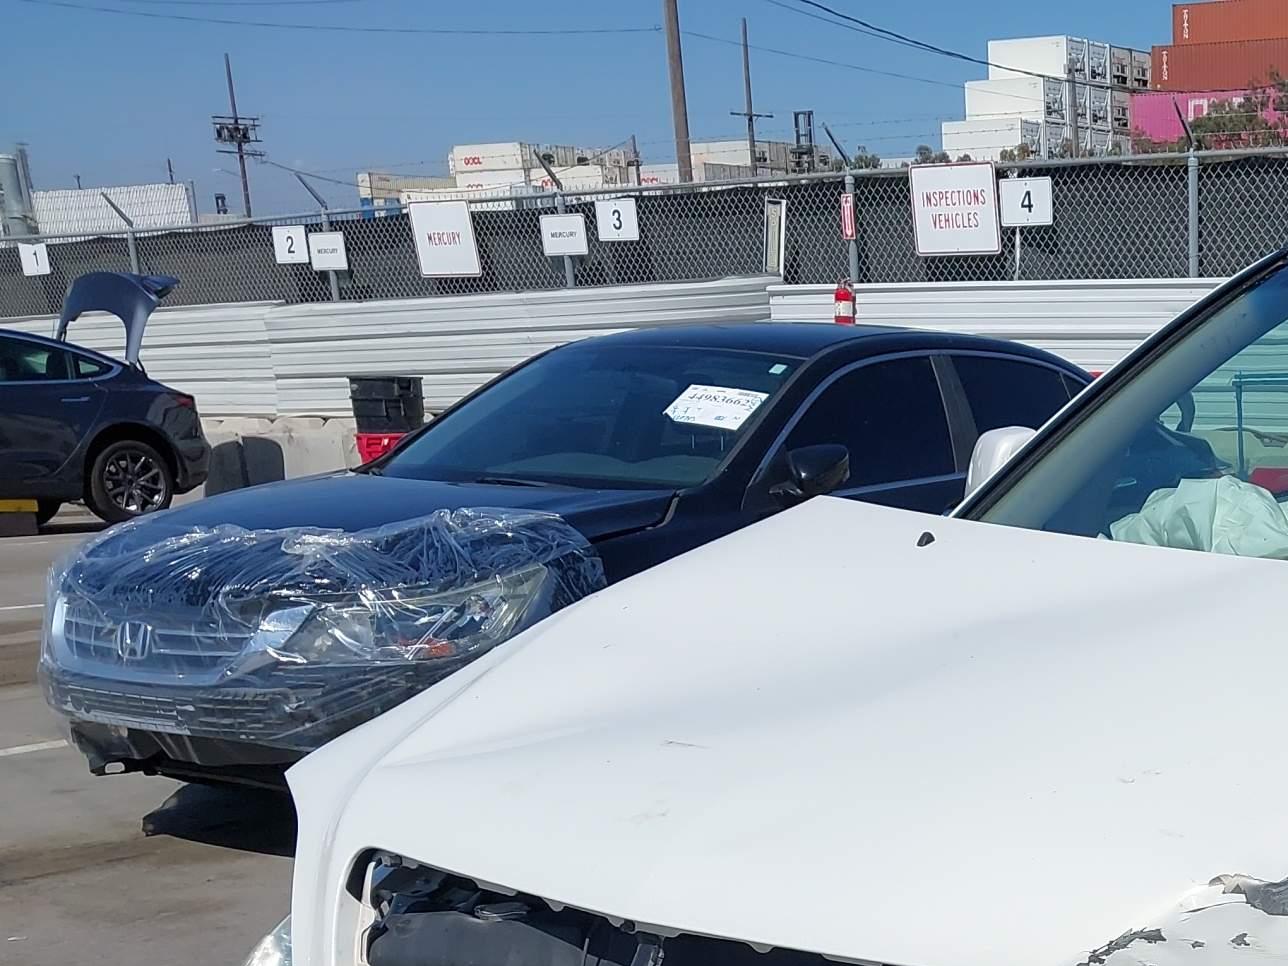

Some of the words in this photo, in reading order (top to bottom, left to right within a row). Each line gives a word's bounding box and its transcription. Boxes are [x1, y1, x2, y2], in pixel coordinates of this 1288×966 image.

[464, 157, 482, 165] OOCL
[922, 189, 986, 207] INSPECTIONS
[1021, 190, 1034, 213] 4
[612, 209, 622, 230] 3
[931, 212, 979, 229] VEHICLES
[427, 231, 461, 246] MERCURY
[551, 231, 577, 239] MERCURY
[286, 236, 295, 254] 2
[33, 250, 39, 266] 1
